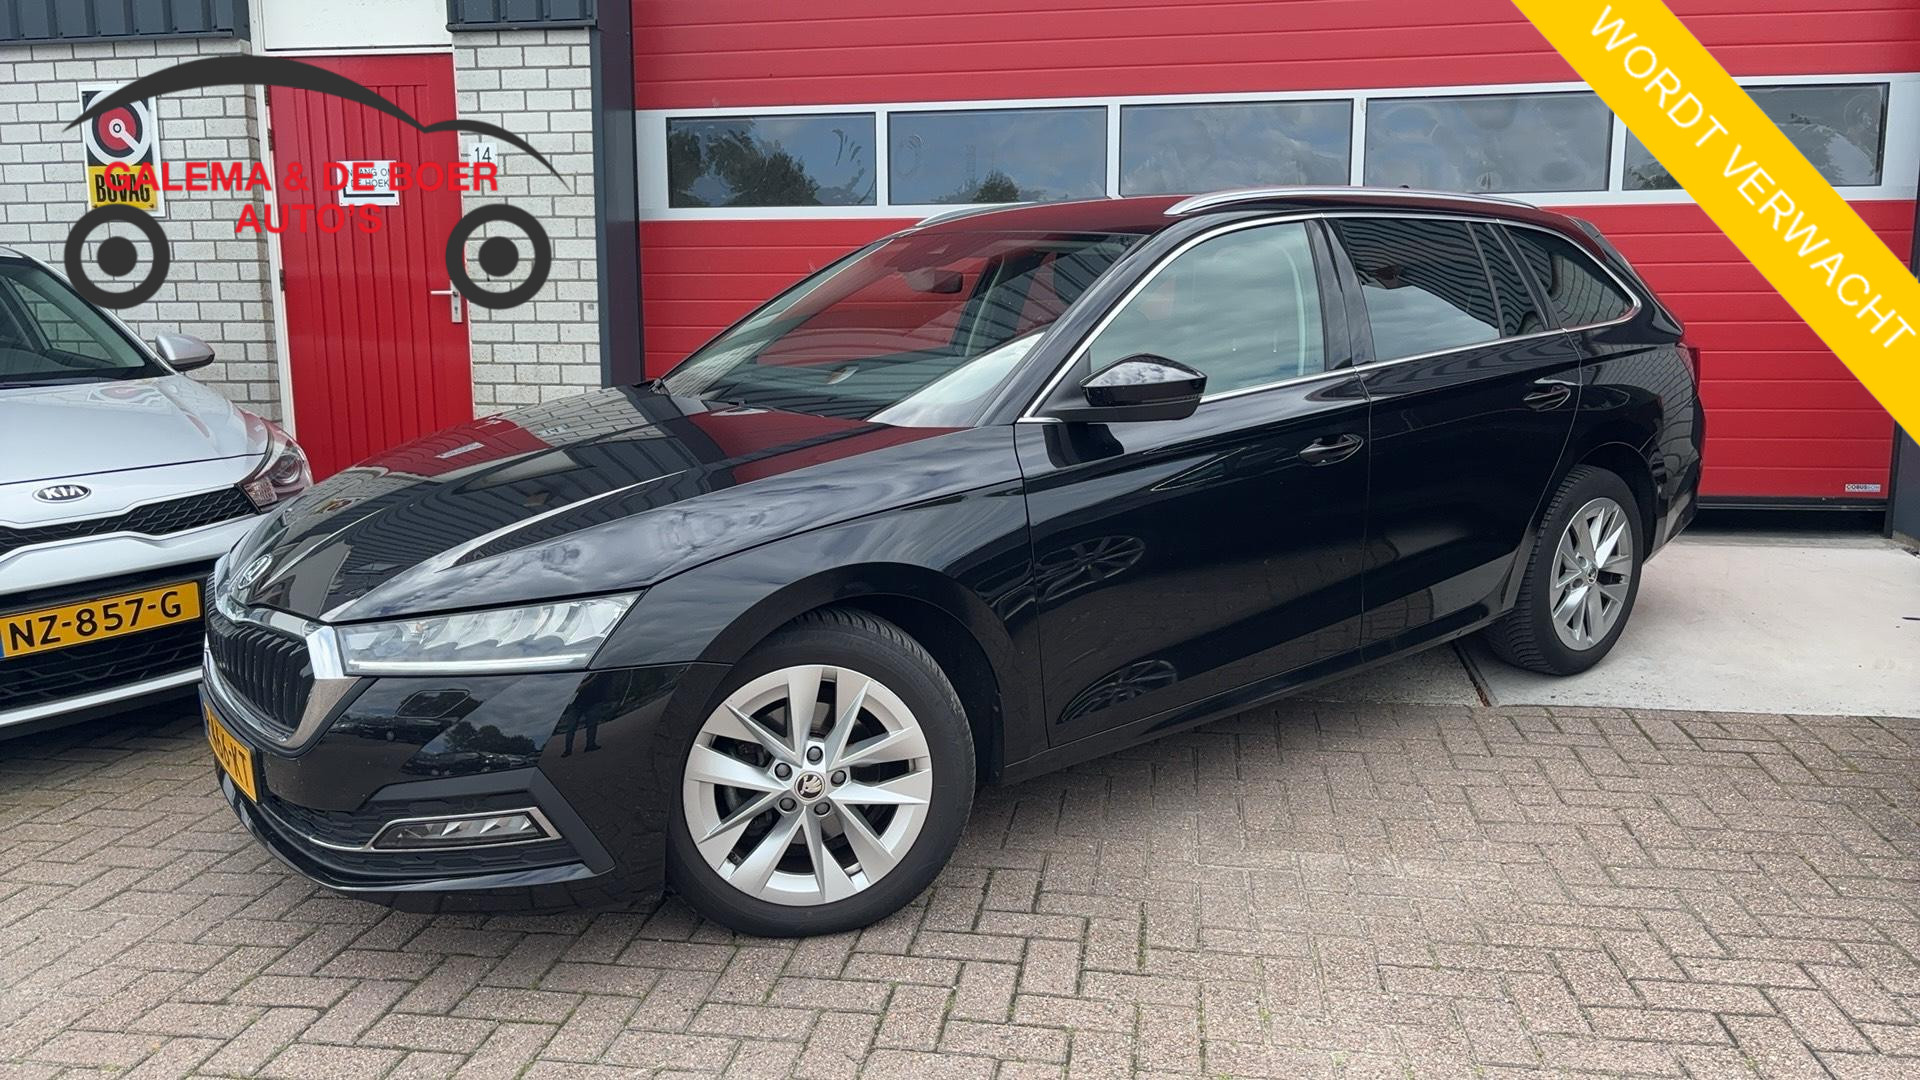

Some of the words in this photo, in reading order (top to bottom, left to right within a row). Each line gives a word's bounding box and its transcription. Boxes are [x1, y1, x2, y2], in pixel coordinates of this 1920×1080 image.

[475, 147, 492, 163] 14
[43, 485, 85, 499] KIA
[9, 591, 181, 650] NZ-857-G
